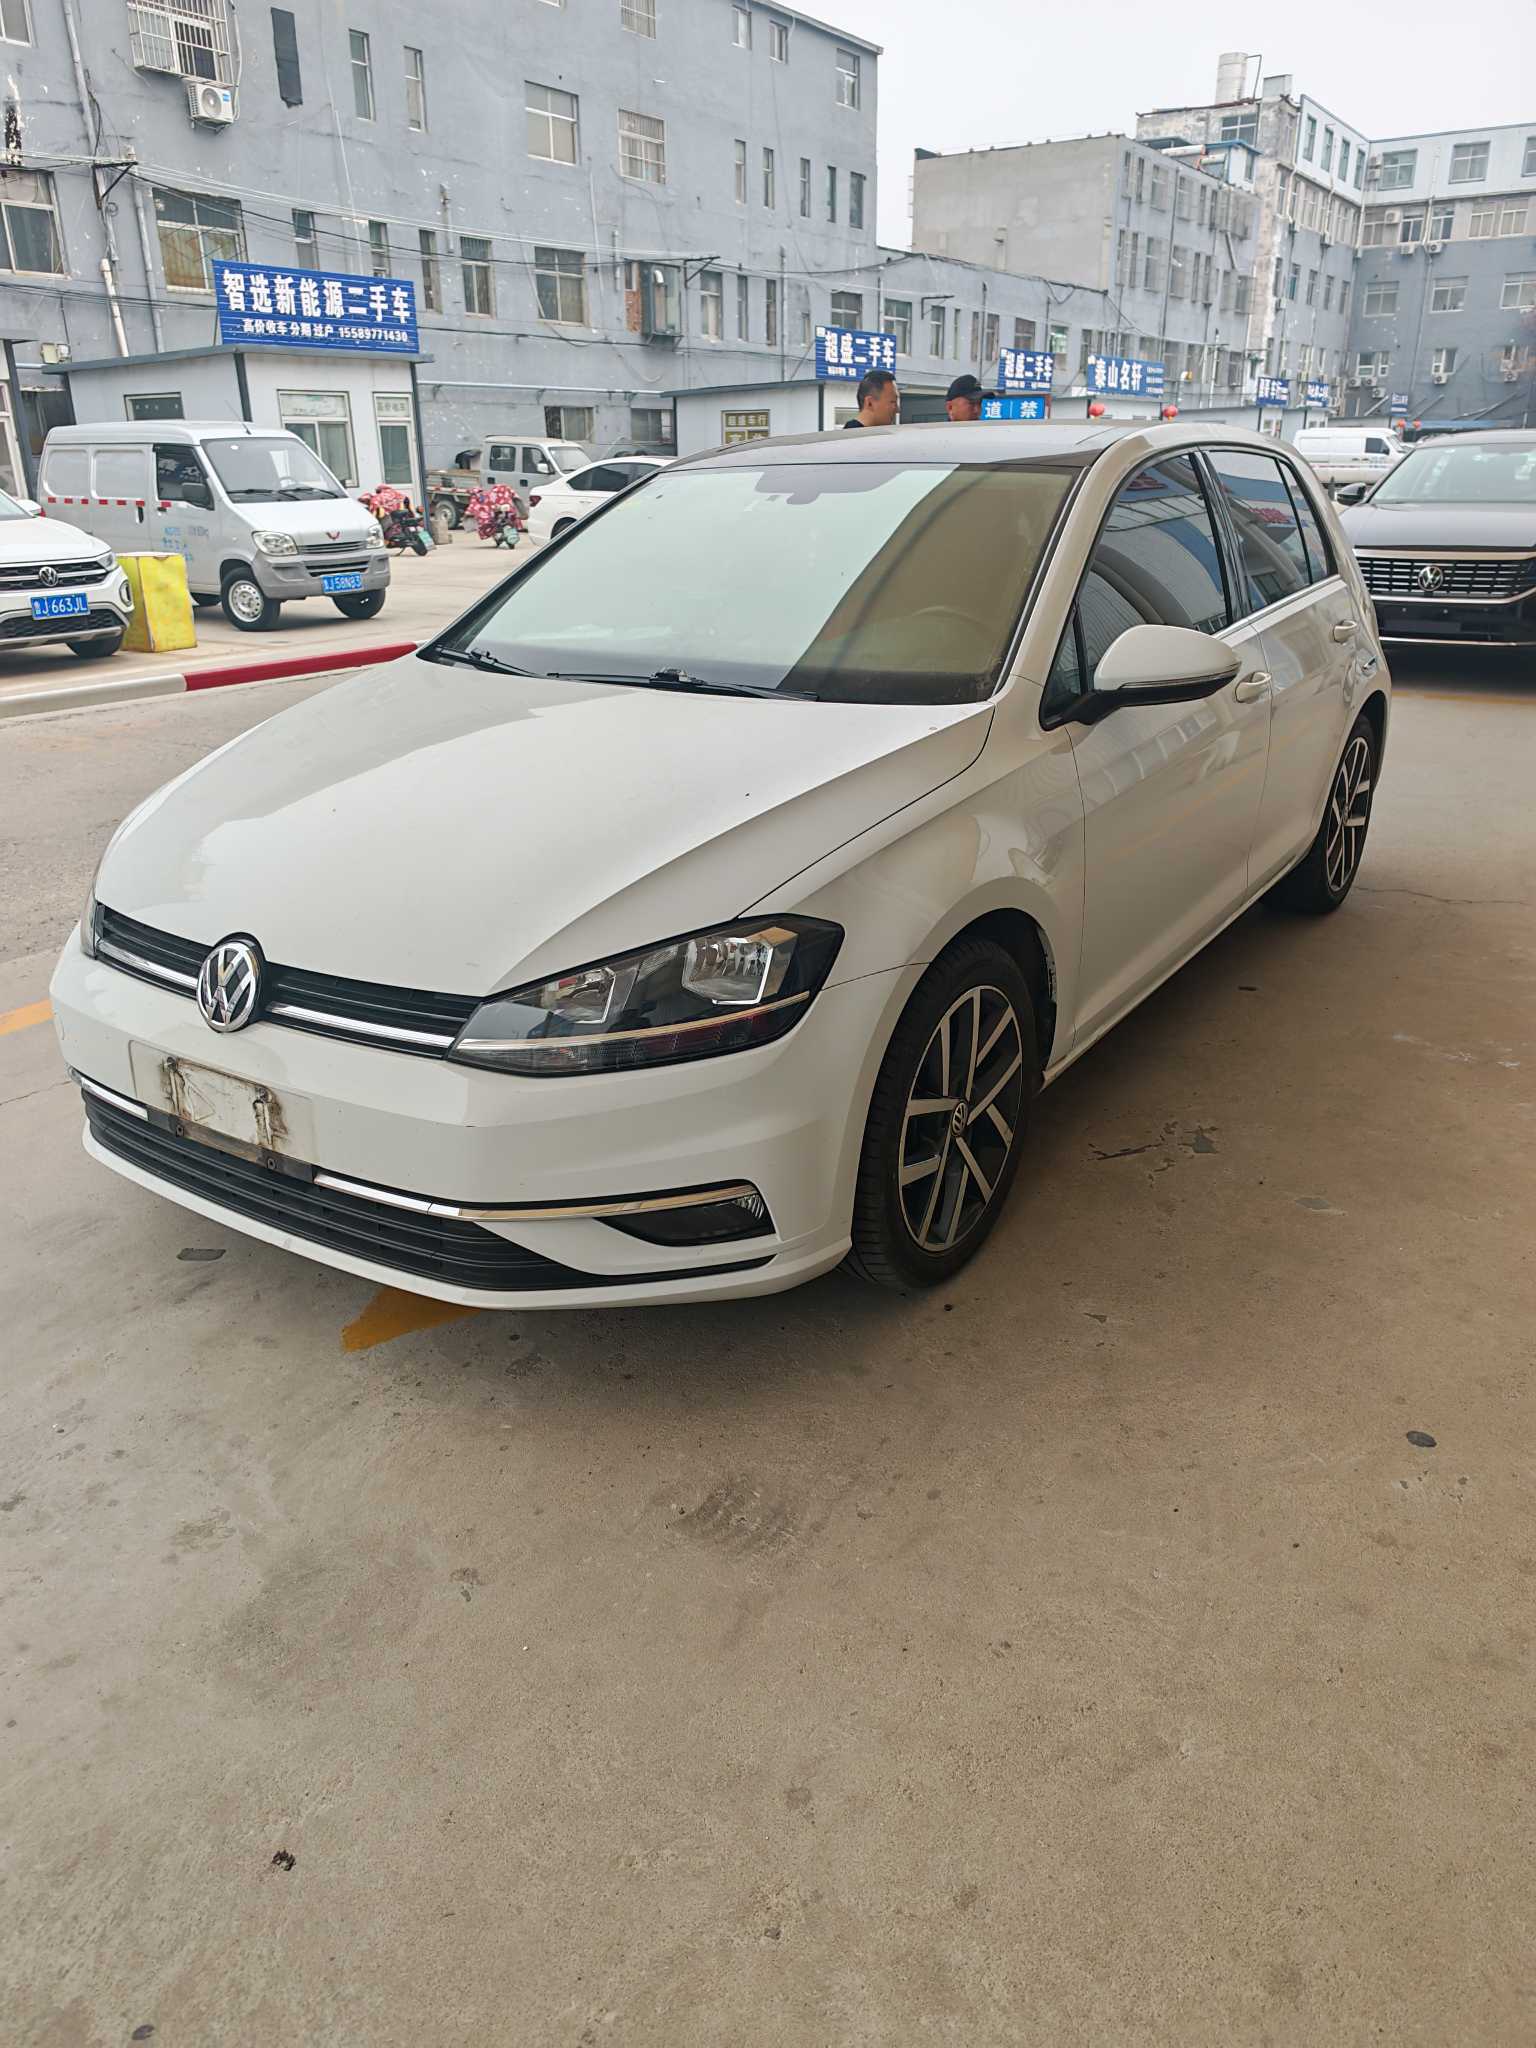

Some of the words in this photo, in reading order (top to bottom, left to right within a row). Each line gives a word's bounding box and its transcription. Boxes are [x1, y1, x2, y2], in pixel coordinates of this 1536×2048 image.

[223, 269, 410, 324] 智选新能源二手车
[1020, 400, 1039, 418] 禁
